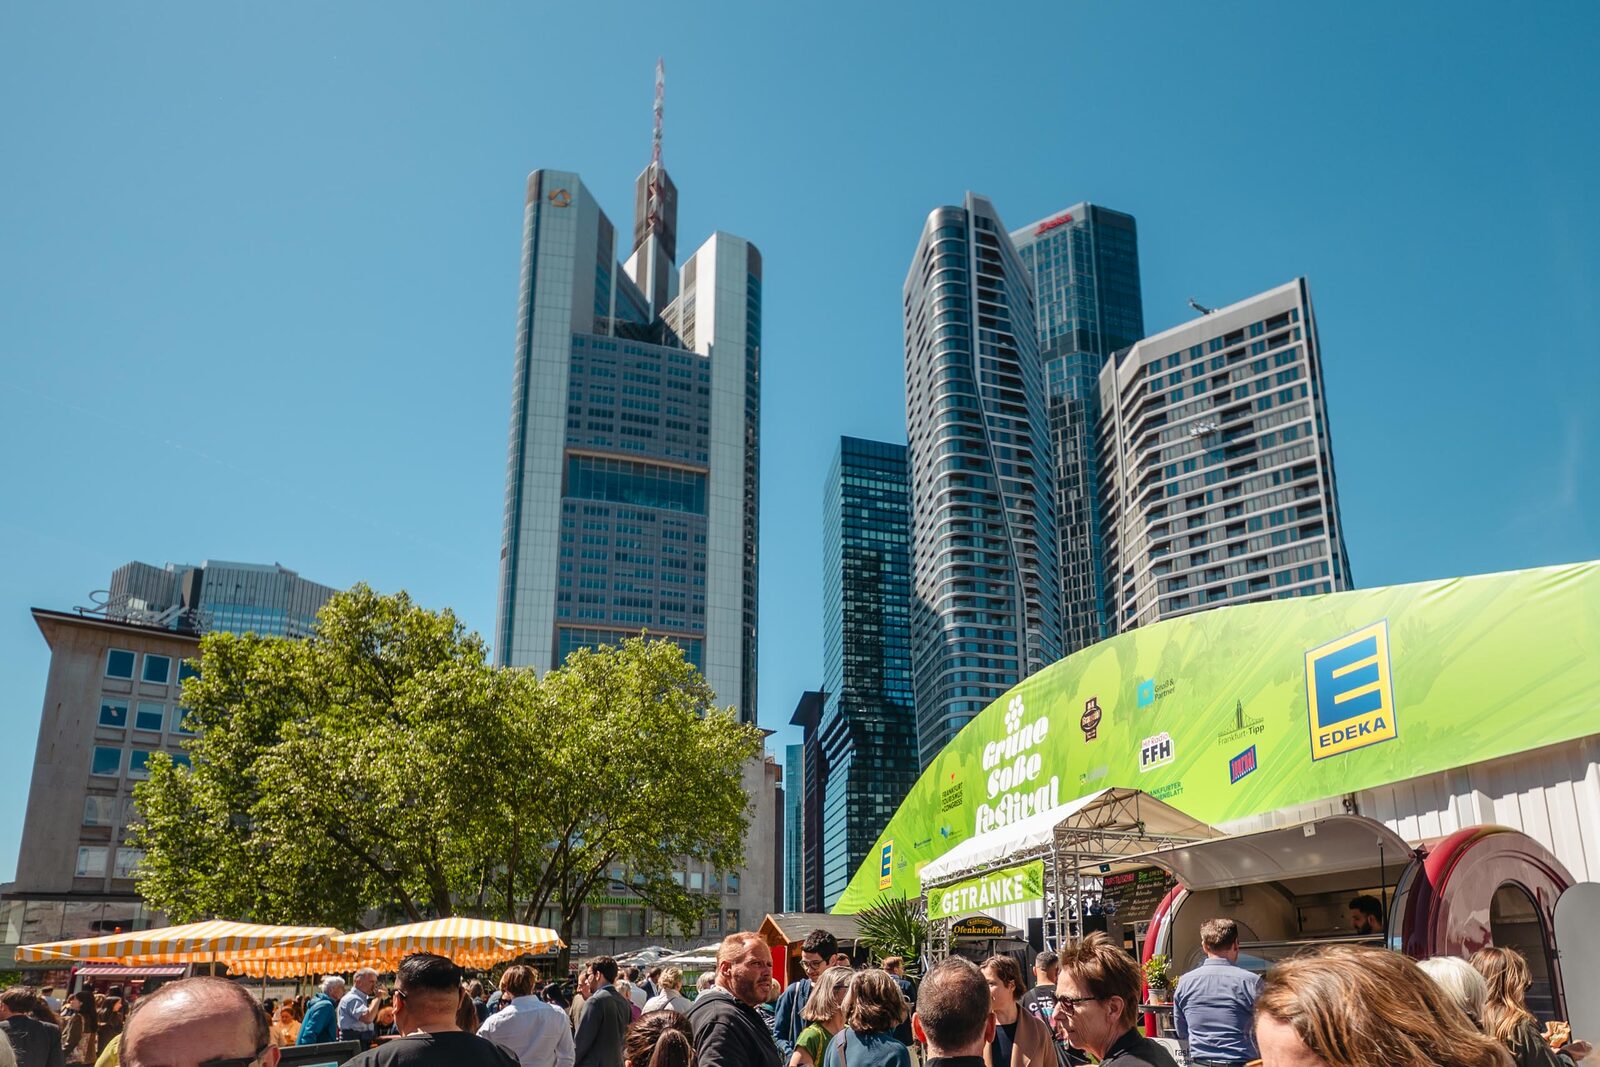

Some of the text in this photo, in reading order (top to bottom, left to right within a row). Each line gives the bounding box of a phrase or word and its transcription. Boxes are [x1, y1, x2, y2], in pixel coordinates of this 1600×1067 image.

[1154, 687, 1175, 701] Partner
[1319, 716, 1386, 748] EDEKA
[1142, 740, 1170, 766] FFH
[1148, 781, 1181, 796] ANKFURTER
[942, 874, 1024, 914] GETRÄNKE
[953, 925, 1005, 934] Ofenkartoffel
